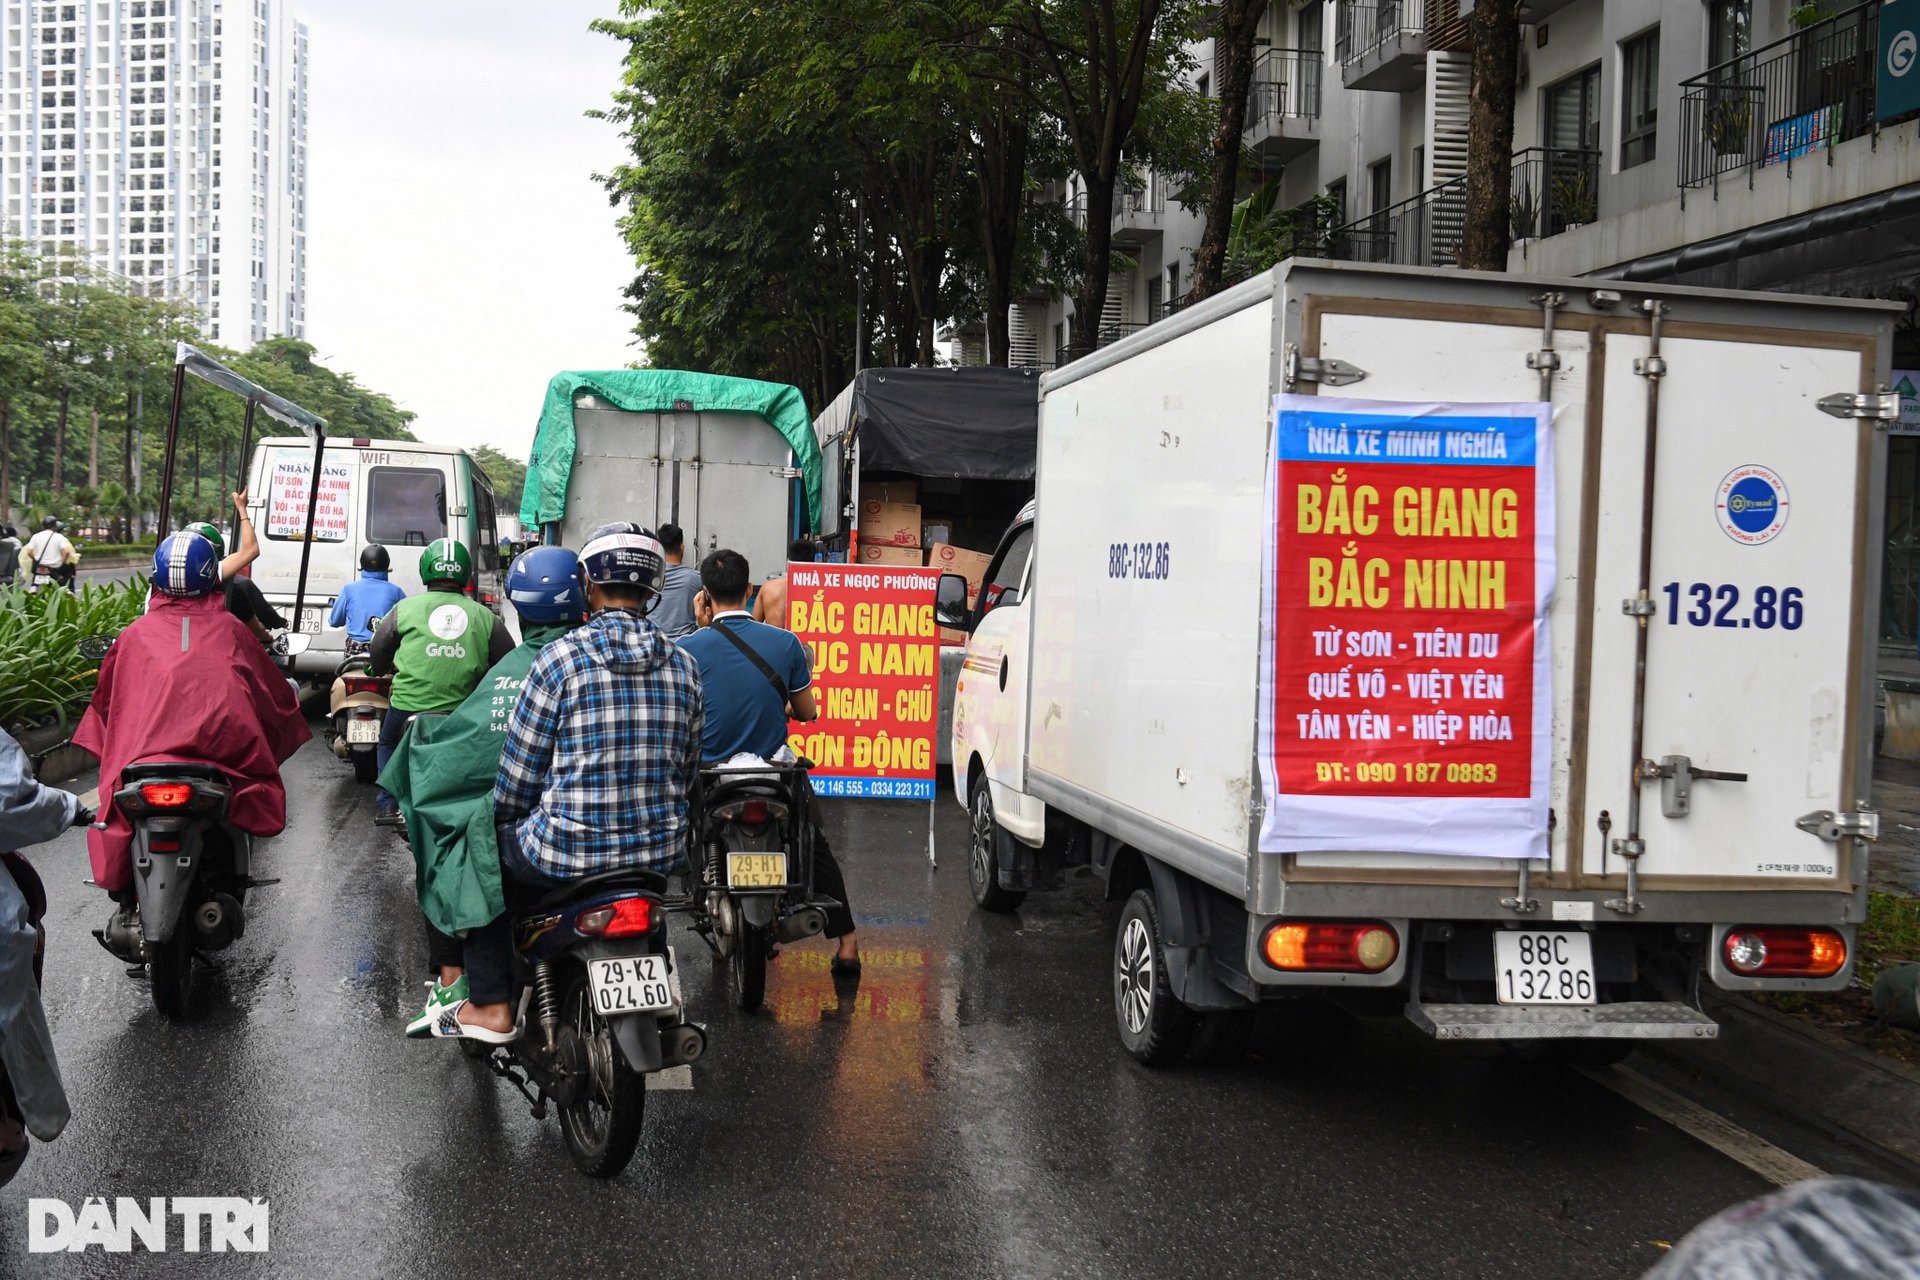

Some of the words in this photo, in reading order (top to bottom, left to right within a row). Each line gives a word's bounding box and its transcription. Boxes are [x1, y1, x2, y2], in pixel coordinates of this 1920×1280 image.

[1308, 423, 1349, 454] NHÀ
[1355, 430, 1380, 456] XE
[1386, 430, 1439, 457] MINH
[1446, 428, 1507, 458] NGHĨA
[278, 463, 311, 475] NHẬN
[320, 466, 347, 477] ÀNG
[361, 451, 390, 464] WIFI
[286, 477, 303, 487] SƠN
[329, 480, 350, 490] NINH
[1298, 468, 1379, 535] BẮC
[1393, 487, 1518, 538] GIANG
[327, 520, 347, 530] NAM
[434, 562, 462, 573] Grab
[1109, 542, 1170, 580] 88C-132.86
[1309, 541, 1390, 608] BẮC
[1404, 559, 1505, 609] NINH
[793, 570, 820, 587] NHÀ
[824, 573, 840, 588] XE
[844, 574, 879, 591] NGỌC
[884, 574, 937, 591] PHƯỜNG
[790, 590, 845, 634] BẮC
[853, 603, 935, 637] GIANG
[1663, 582, 1804, 630] 132.86
[425, 642, 466, 659] Grab
[1313, 625, 1342, 657] TỪ
[1346, 629, 1392, 657] SƠN
[1413, 627, 1462, 658] TIÊN
[1469, 633, 1499, 658] DU
[807, 641, 849, 680] ỤC
[859, 642, 934, 676] NAM
[1308, 663, 1353, 699] QUẾ
[1357, 668, 1386, 698] VÕ
[1407, 668, 1454, 704] VIỆT
[1460, 669, 1504, 699] YÊN
[492, 696, 505, 705] 25
[827, 687, 878, 727] NGẠN
[882, 702, 891, 711] -
[895, 684, 932, 723] CHŨ
[1297, 708, 1340, 740] TÂN
[1346, 709, 1391, 740] YÊN
[1413, 710, 1462, 746] HIỆP
[1469, 709, 1513, 740] HÒA
[787, 732, 845, 768] SƠN
[852, 730, 931, 776] ĐỘNG
[1316, 762, 1350, 782] ĐT:
[1356, 763, 1396, 783] 090
[1402, 763, 1441, 783] 187
[1446, 763, 1497, 783] 0883
[828, 780, 844, 794] 146
[846, 781, 863, 794] 555
[871, 782, 893, 795] 0334
[895, 782, 912, 796] 223
[914, 783, 930, 797] 211
[736, 855, 777, 872] 29-H1
[1803, 864, 1833, 875] 1000kg
[1519, 935, 1569, 965] 88C
[601, 959, 657, 985] 29-K2
[1505, 969, 1591, 1000] 132.86
[600, 983, 668, 1010] 024.60
